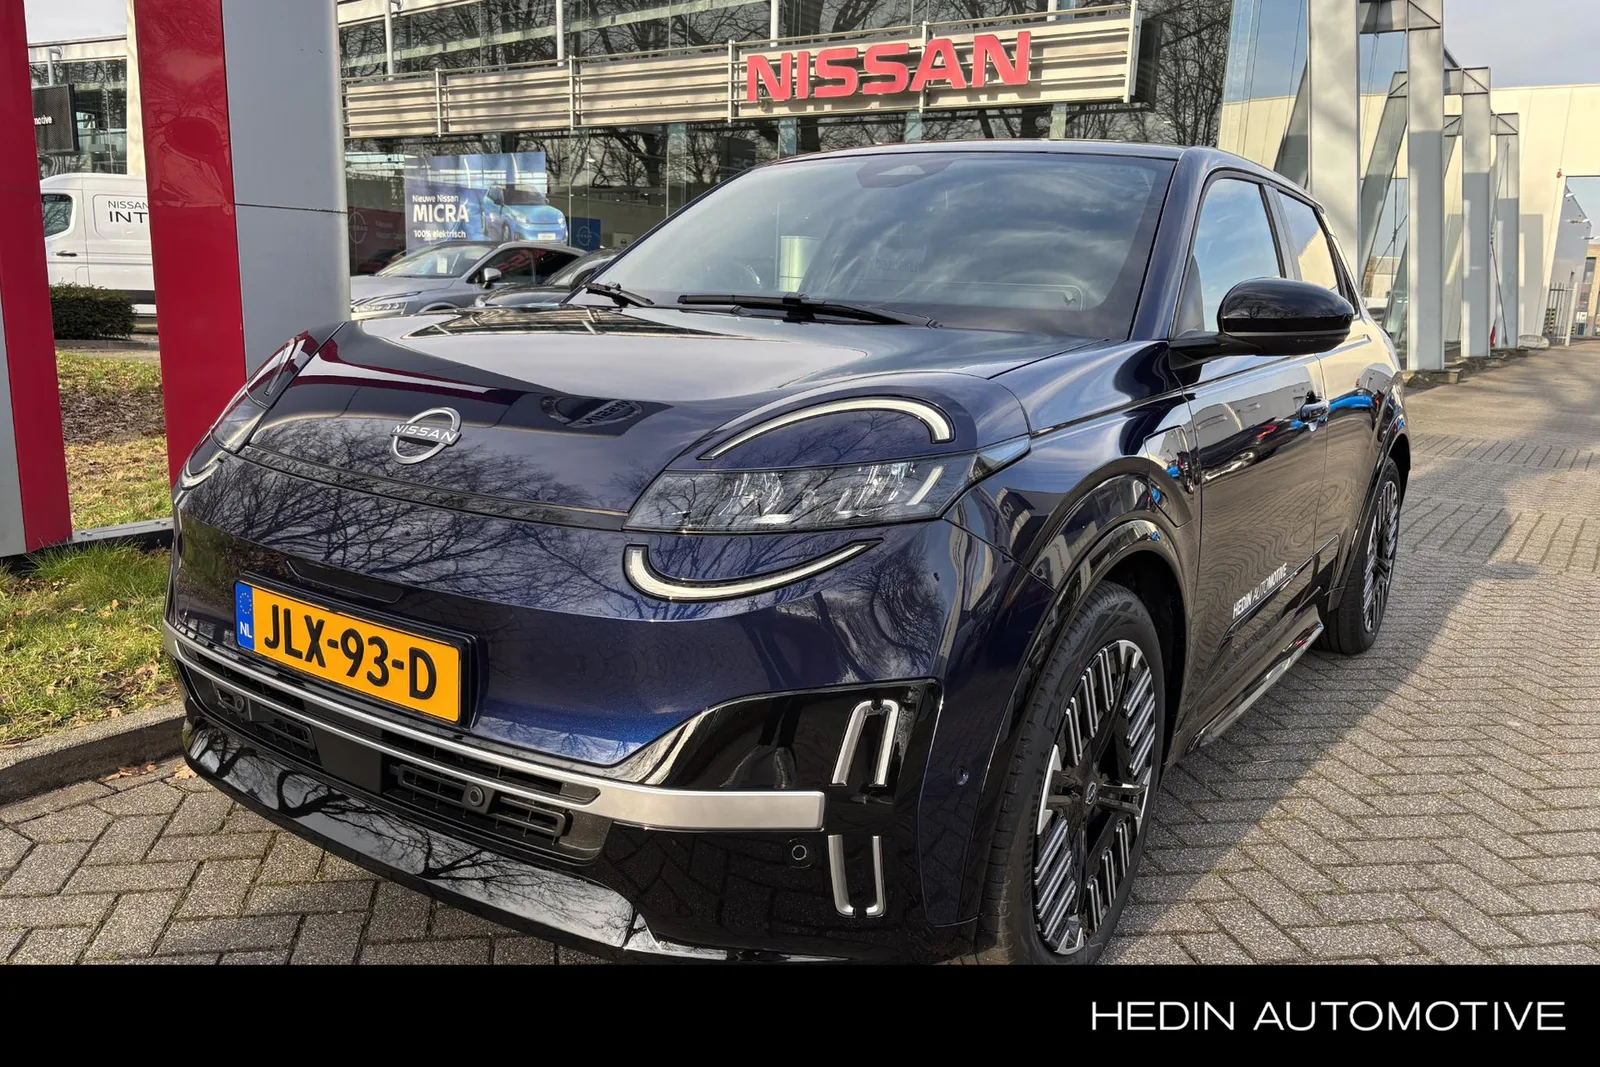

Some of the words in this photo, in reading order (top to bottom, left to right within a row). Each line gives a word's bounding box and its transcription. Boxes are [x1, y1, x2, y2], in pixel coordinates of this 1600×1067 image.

[747, 31, 1031, 101] NISSAN
[412, 194, 436, 203] Nieuwe
[437, 194, 459, 203] Nissan
[413, 203, 470, 223] MICRA
[414, 229, 432, 238] 100%
[433, 229, 467, 239] elektrisch
[392, 424, 457, 442] NISSAN
[239, 621, 253, 639] NL
[264, 603, 437, 700] JLX-93-D
